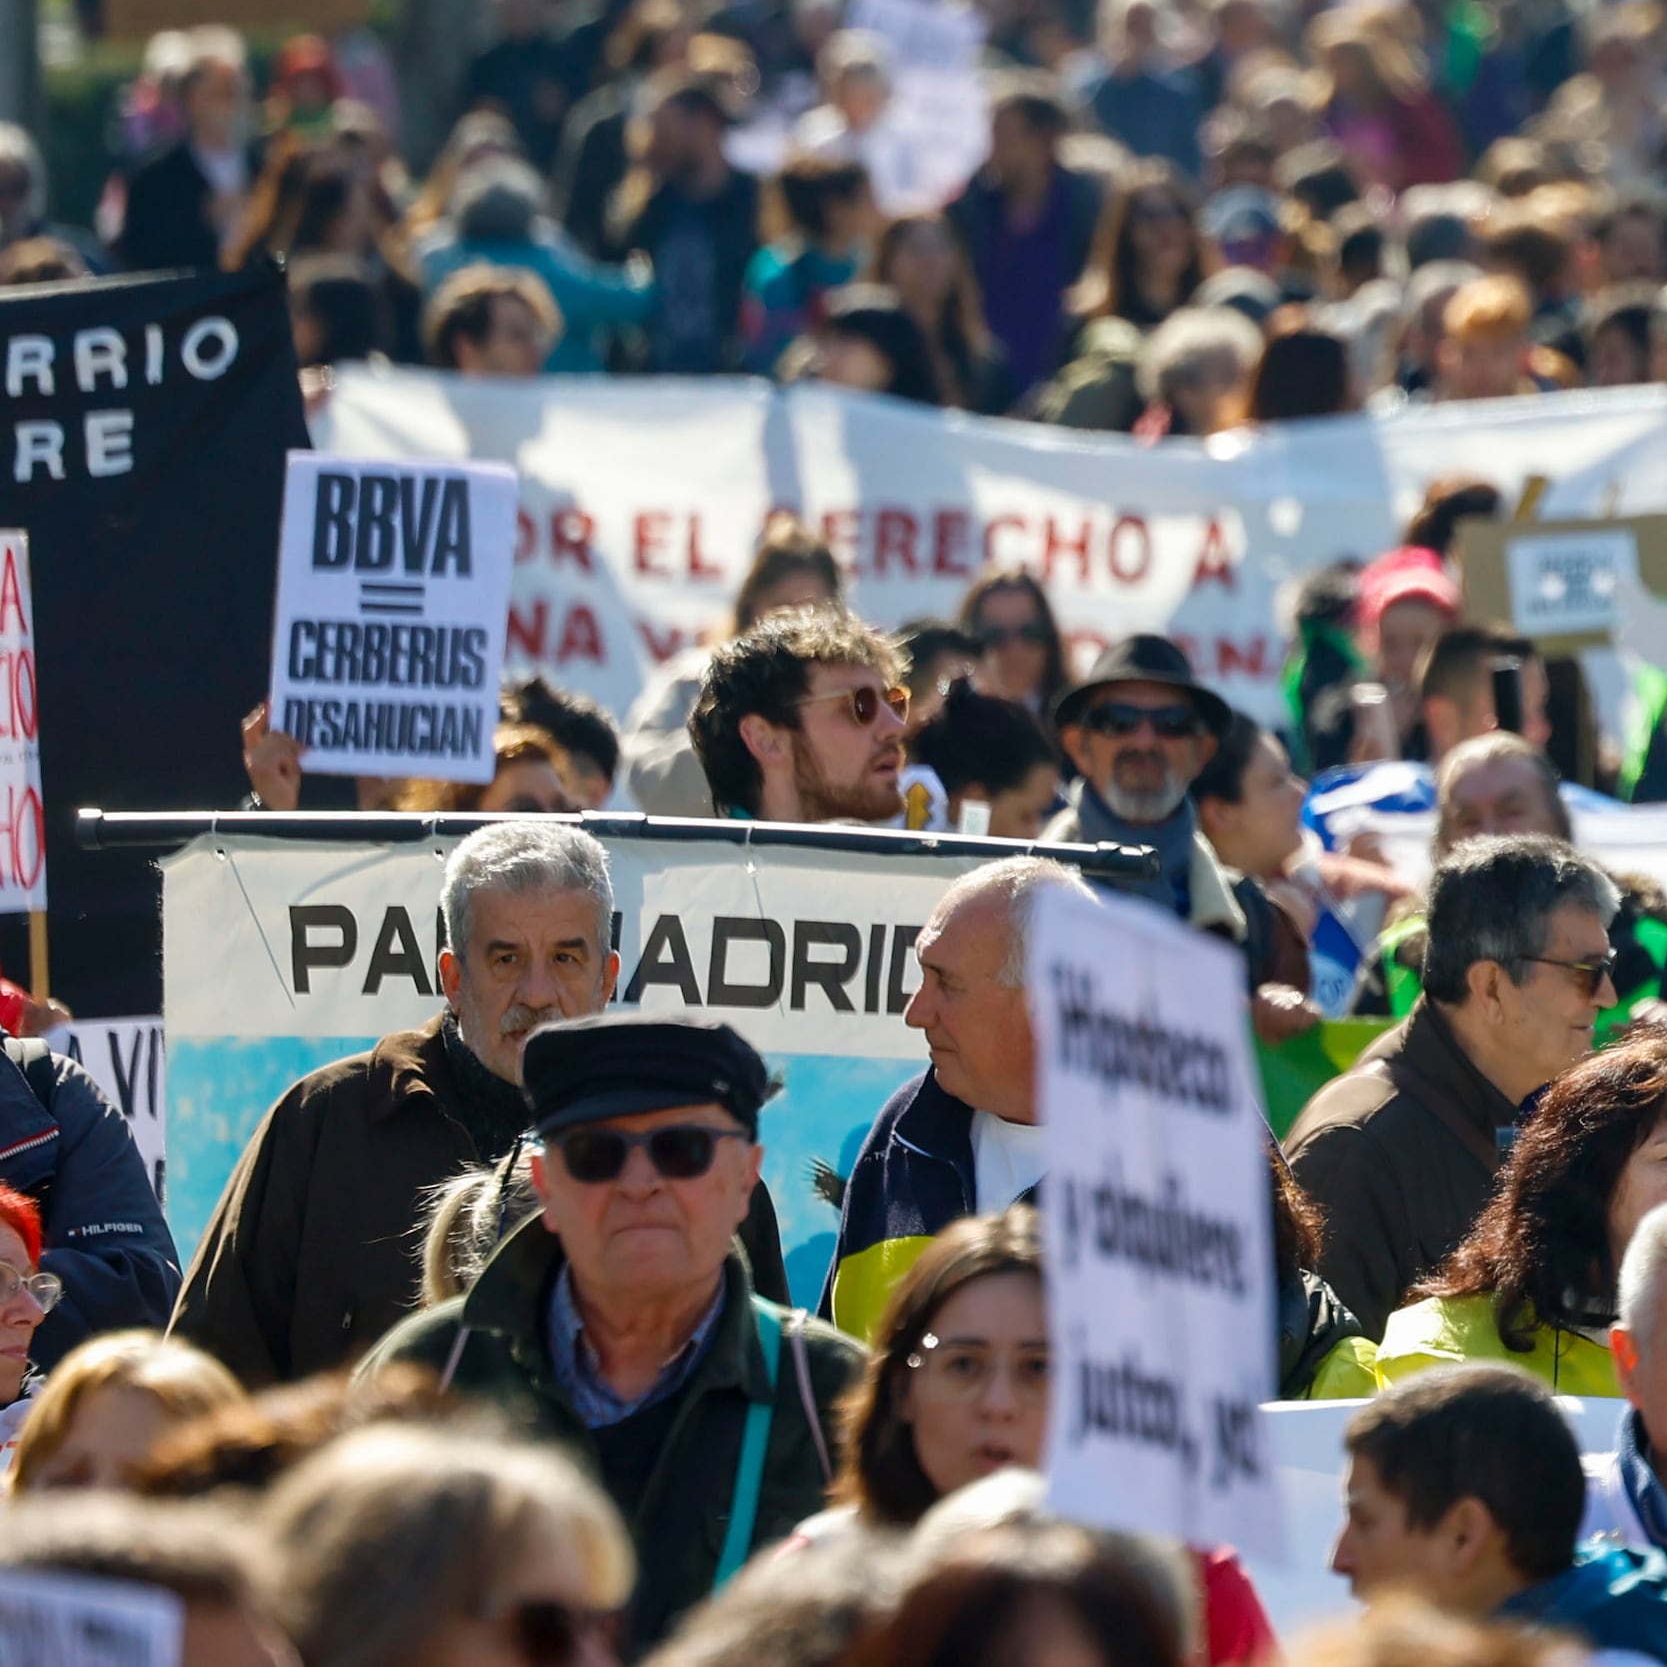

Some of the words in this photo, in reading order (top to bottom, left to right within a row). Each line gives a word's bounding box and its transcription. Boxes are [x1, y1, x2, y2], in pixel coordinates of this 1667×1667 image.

[312, 472, 474, 580] BBVA
[512, 504, 597, 574] OR
[632, 506, 726, 580] EL
[762, 502, 1154, 584] ERECHO
[1194, 514, 1237, 590] A
[288, 618, 488, 692] CERBERUS
[503, 599, 606, 668] NA
[283, 696, 486, 760] DESAHUCIAN
[289, 904, 446, 996] PA
[612, 912, 925, 1018] ADRI
[81, 1221, 144, 1236] HILFIGER
